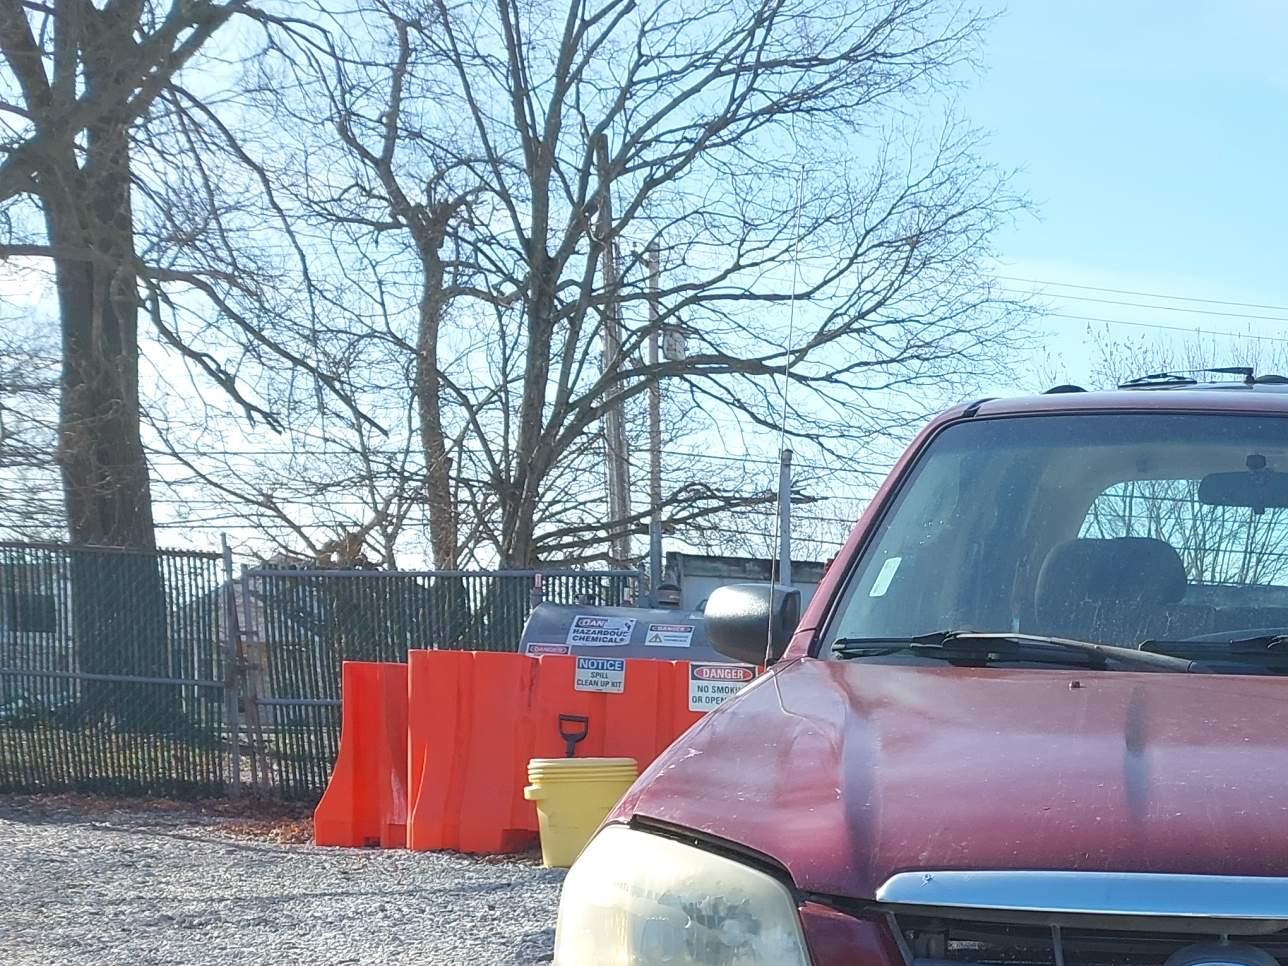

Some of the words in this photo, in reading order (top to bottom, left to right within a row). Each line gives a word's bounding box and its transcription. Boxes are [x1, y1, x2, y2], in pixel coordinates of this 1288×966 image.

[579, 659, 622, 670] NOTICE
[590, 671, 609, 679] SPILL
[703, 668, 744, 679] DANGER
[577, 679, 599, 687] CLEAN
[697, 685, 709, 693] NO
